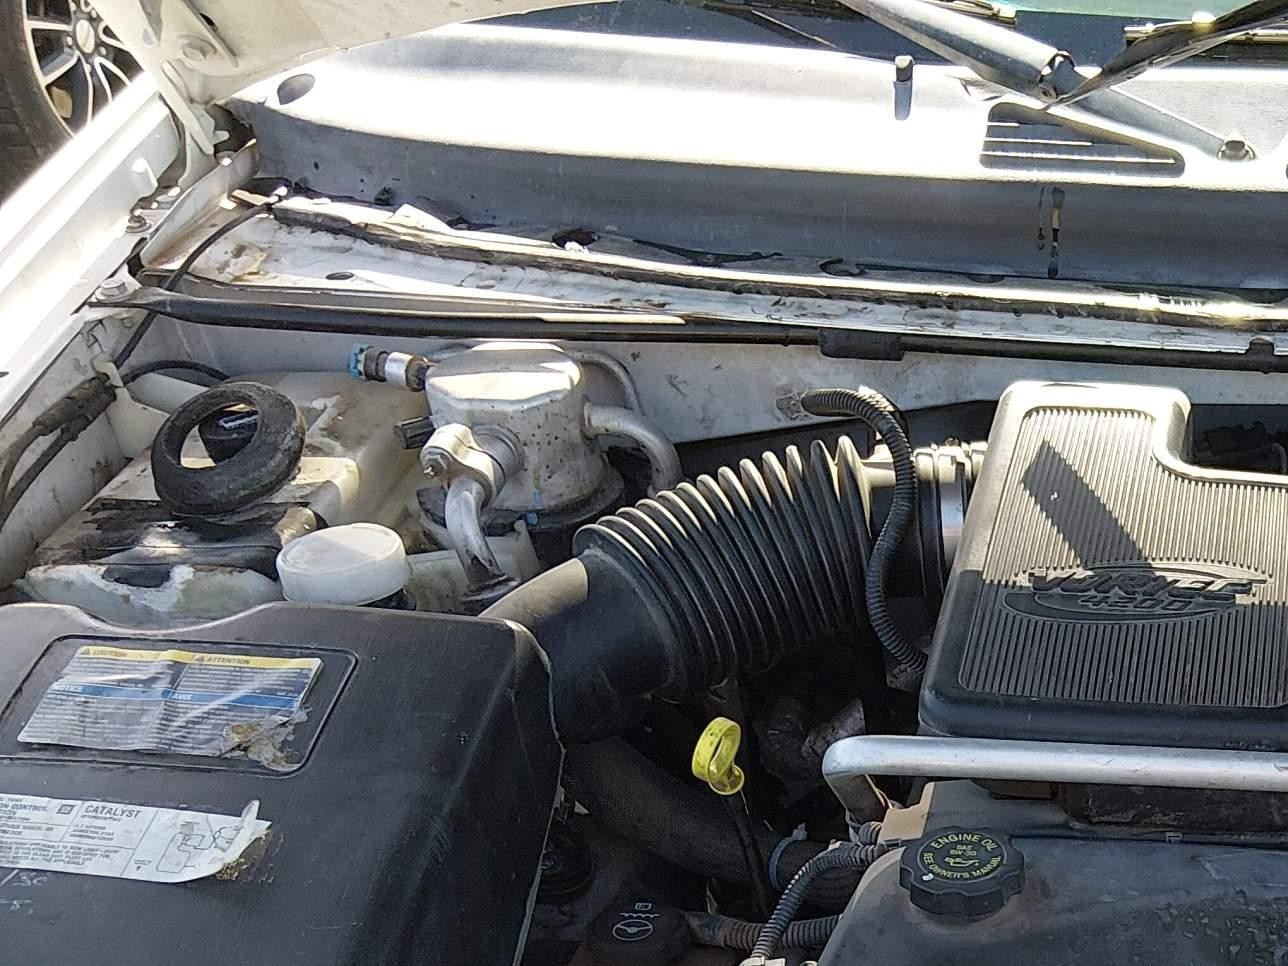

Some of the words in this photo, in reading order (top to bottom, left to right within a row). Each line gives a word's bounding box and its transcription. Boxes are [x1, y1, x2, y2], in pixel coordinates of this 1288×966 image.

[1077, 594, 1194, 613] 4200
[92, 648, 127, 658] CAUTION
[207, 656, 250, 665] ATTENTION
[52, 683, 83, 694] NOTICE
[85, 804, 142, 819] CATALYST
[930, 833, 982, 849] ENGINE
[981, 837, 999, 852] OIL
[923, 852, 935, 865] SEE
[929, 862, 970, 879] OWNER'S
[970, 855, 1002, 878] MANUAL
